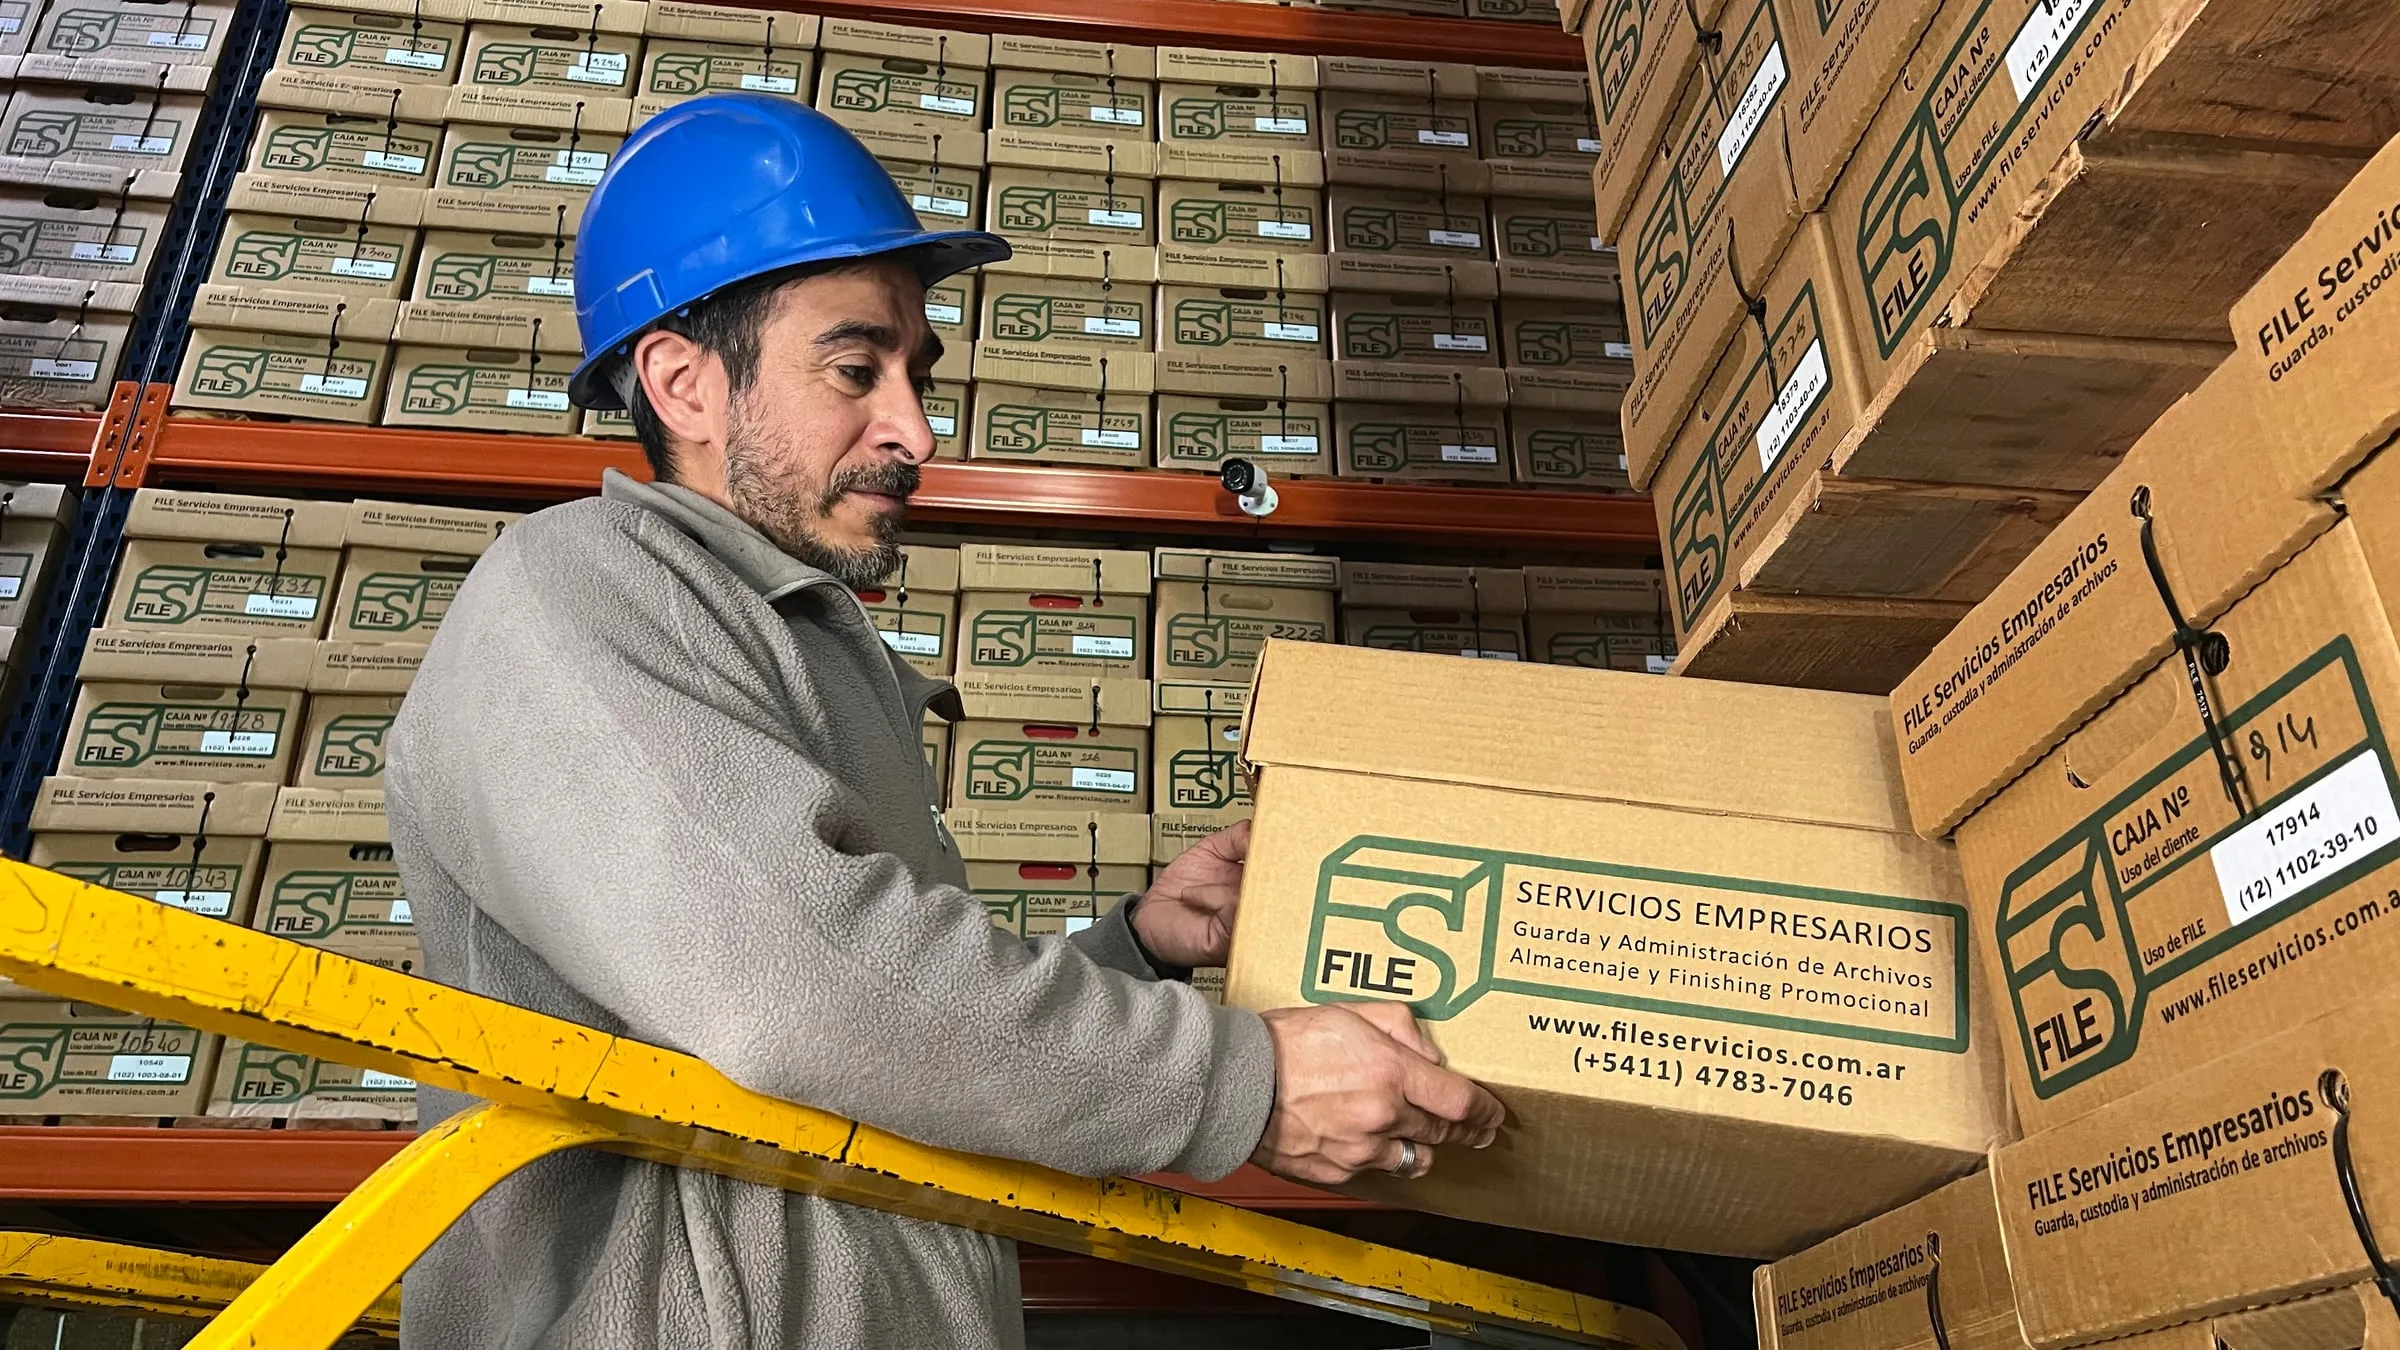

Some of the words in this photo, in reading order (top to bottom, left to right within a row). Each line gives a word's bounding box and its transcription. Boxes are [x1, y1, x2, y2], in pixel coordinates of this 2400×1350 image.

[294, 51, 329, 64] FILE
[1607, 45, 1630, 108] FILE
[1935, 63, 1970, 119] CAJA
[1970, 27, 1990, 66] Nº
[2026, 44, 2049, 82] (12)
[1727, 139, 1740, 165] (12)
[1741, 73, 1777, 138] 1103-40-04
[1738, 84, 1758, 120] 18382
[1800, 75, 1822, 122] FILE
[1940, 113, 1956, 138] Uso
[1956, 90, 1969, 115] del
[1968, 52, 1998, 95] cliente
[1600, 148, 1613, 180] FILE
[1612, 88, 1640, 153] Servicios
[1682, 142, 1701, 180] CAJA
[1955, 165, 1971, 190] Uso
[1972, 148, 1982, 167] de
[1981, 120, 2000, 151] FILE
[229, 295, 270, 305] Servicios
[270, 299, 329, 312] Empresarios
[1647, 274, 1674, 334] FILE
[1881, 248, 1928, 336] FILE
[2269, 324, 2334, 382] Guarda,
[2336, 251, 2400, 322] custodi
[1352, 342, 1381, 353] FILE
[1630, 383, 1644, 417] FILE
[1645, 330, 1675, 391] Servicios
[1676, 241, 1722, 334] Empresarios
[2258, 286, 2315, 357] FILE
[198, 379, 237, 392] FILE
[1776, 380, 1798, 415] 18379
[992, 436, 1026, 447] FILE
[1718, 422, 1738, 460] CAJA
[1767, 434, 1781, 460] (12)
[1781, 374, 1818, 435] 1103-40-01
[1733, 407, 1830, 549] www.fileservicios.com.ar
[154, 497, 175, 506] FILE
[177, 499, 221, 509] Servicios
[223, 503, 286, 516] Empresarios
[211, 574, 236, 583] CAJA
[1684, 556, 1711, 615] FILE
[133, 602, 172, 617] FILE
[1904, 693, 1933, 736] FILE
[1934, 635, 2000, 708] Servicios
[2001, 533, 2108, 645] Empresarios
[95, 638, 118, 647] FILE
[118, 639, 166, 649] Servicios
[168, 641, 232, 652] Empresarios
[978, 648, 1011, 661] FILE
[1908, 723, 1942, 755] Guarda,
[1942, 688, 1979, 726] custodia
[1979, 680, 1985, 696] y
[1986, 616, 2056, 686] administración
[2057, 602, 2070, 621] de
[2071, 559, 2117, 607] archivos
[964, 681, 982, 690] FILE
[984, 682, 1024, 691] Servicios
[1026, 684, 1082, 694] Empresarios
[165, 712, 191, 721] CAJA
[84, 746, 125, 761] FILE
[1036, 750, 1058, 758] CAJA
[53, 789, 75, 798] FILE
[77, 790, 125, 800] Servicios
[128, 792, 194, 803] Empresarios
[973, 780, 1007, 794] FILE
[2111, 808, 2162, 861] CAJA
[2161, 786, 2190, 824] Nº
[2266, 802, 2320, 846] 17914
[118, 870, 144, 879] CAJA
[2120, 864, 2142, 885] Uso
[2143, 846, 2161, 871] del
[2161, 826, 2200, 859] cliente
[2239, 876, 2272, 912] (12)
[2276, 816, 2377, 885] 1102-39-10
[274, 916, 315, 931] FILE
[1517, 881, 1681, 922] SERVICIOS
[1696, 902, 1931, 953] EMPRESARIOS
[2143, 945, 2165, 966] Uso
[2167, 934, 2182, 954] de
[2181, 918, 2206, 945] FILE
[1320, 948, 1417, 998] FILE
[1509, 947, 1639, 981] Almacenaje
[1649, 969, 1660, 985] y
[1670, 968, 1772, 1000] Finishing
[1782, 982, 1928, 1017] Promocional
[1514, 921, 1590, 945] Guarda
[1599, 935, 1611, 951] y
[1618, 934, 1787, 970] Administración
[1798, 956, 1824, 975] de
[1833, 961, 1932, 989] Archivos
[73, 1032, 100, 1041] CAJA
[1529, 1015, 1906, 1081] www.fileservicios.com.ar
[2033, 997, 2103, 1075] FILE
[1574, 1046, 1682, 1087] (+5411)
[1695, 1066, 1852, 1106] 4783-7046
[2027, 1173, 2067, 1211] FILE
[2068, 1146, 2160, 1196] Servicios
[2161, 1090, 2314, 1164] Empresarios
[2034, 1210, 2079, 1237] Guarda,
[2080, 1193, 2130, 1224] custodia
[2130, 1192, 2139, 1212] y
[2141, 1156, 2239, 1204] administración
[2241, 1149, 2261, 1171] de
[2263, 1130, 2327, 1164] archivos
[1778, 1290, 1799, 1317] FILE
[1800, 1275, 1848, 1309] Servicios
[1849, 1244, 1924, 1290] Empresarios
